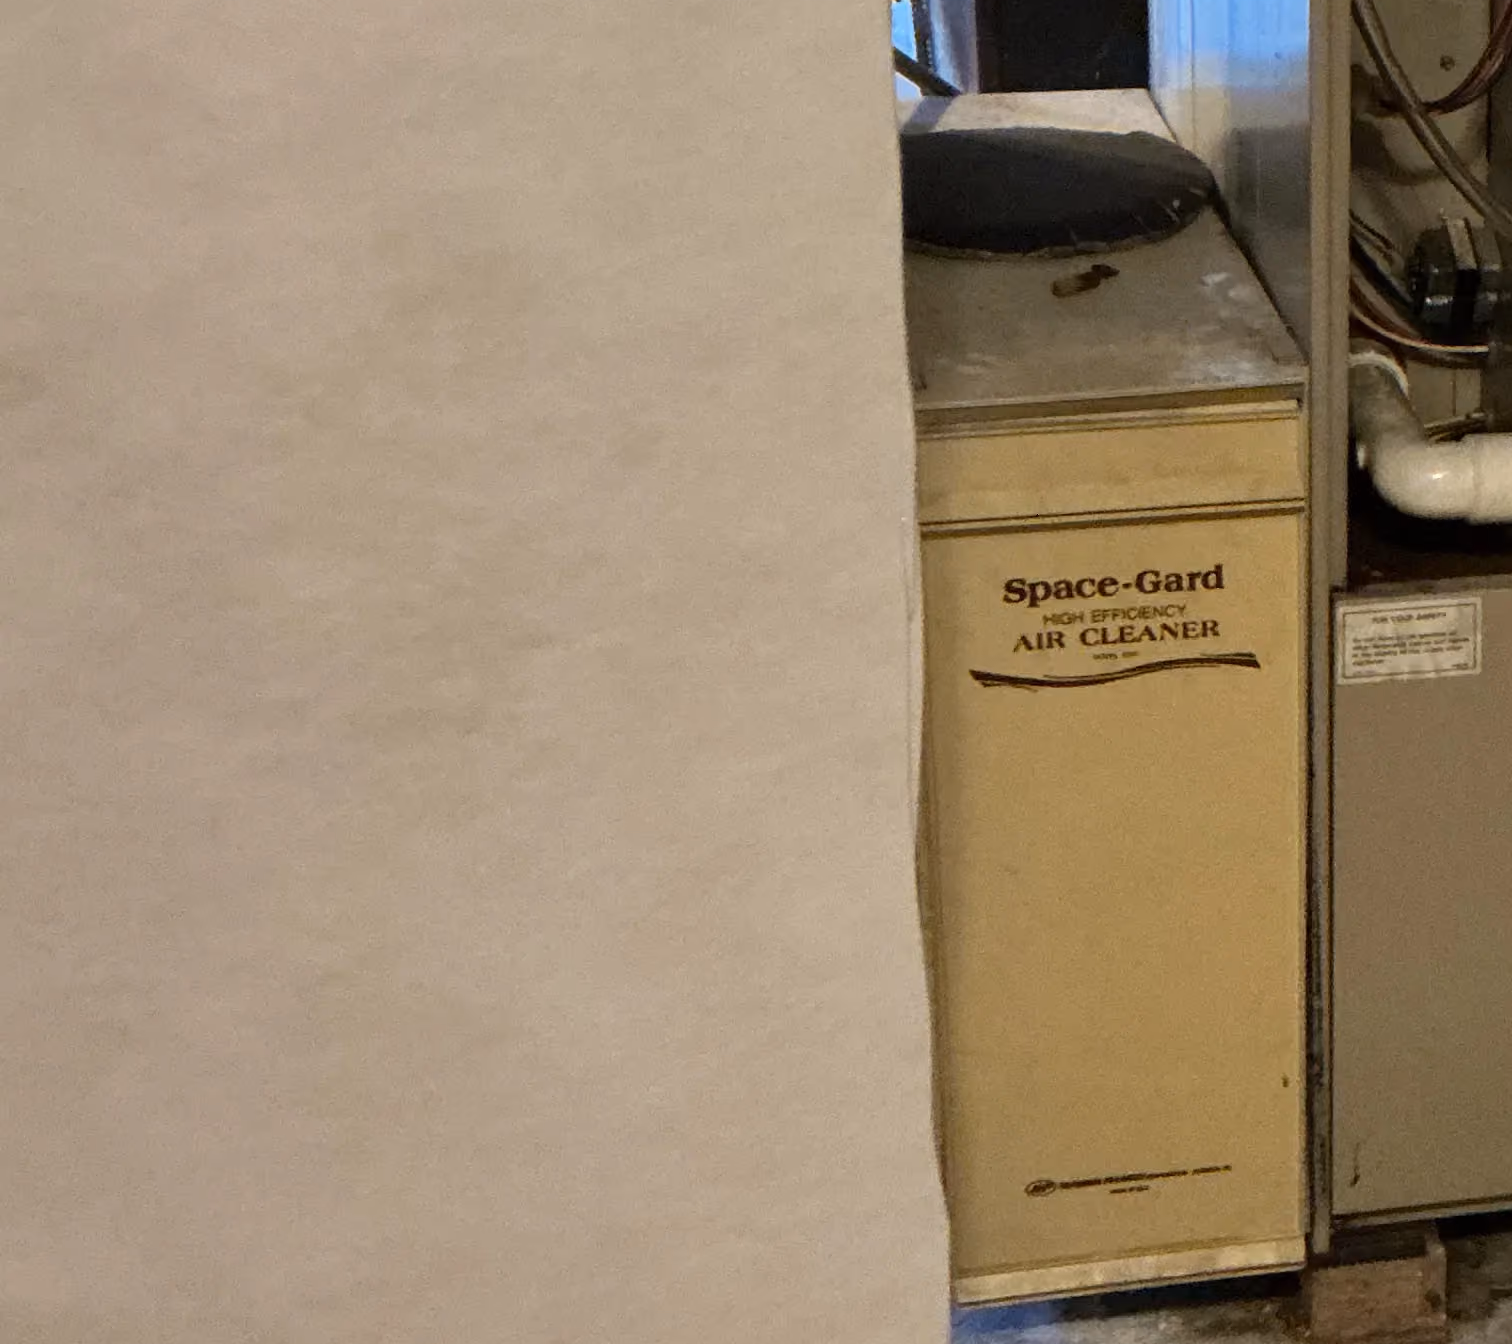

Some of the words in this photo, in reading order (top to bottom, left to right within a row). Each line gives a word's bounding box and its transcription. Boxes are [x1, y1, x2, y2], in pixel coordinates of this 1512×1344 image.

[1002, 563, 1225, 608] Space-Gard
[1043, 612, 1085, 627] HIGH
[1090, 604, 1187, 624] EFFICIENCY
[1013, 630, 1066, 653] AIR
[1078, 619, 1221, 647] CLEANER
